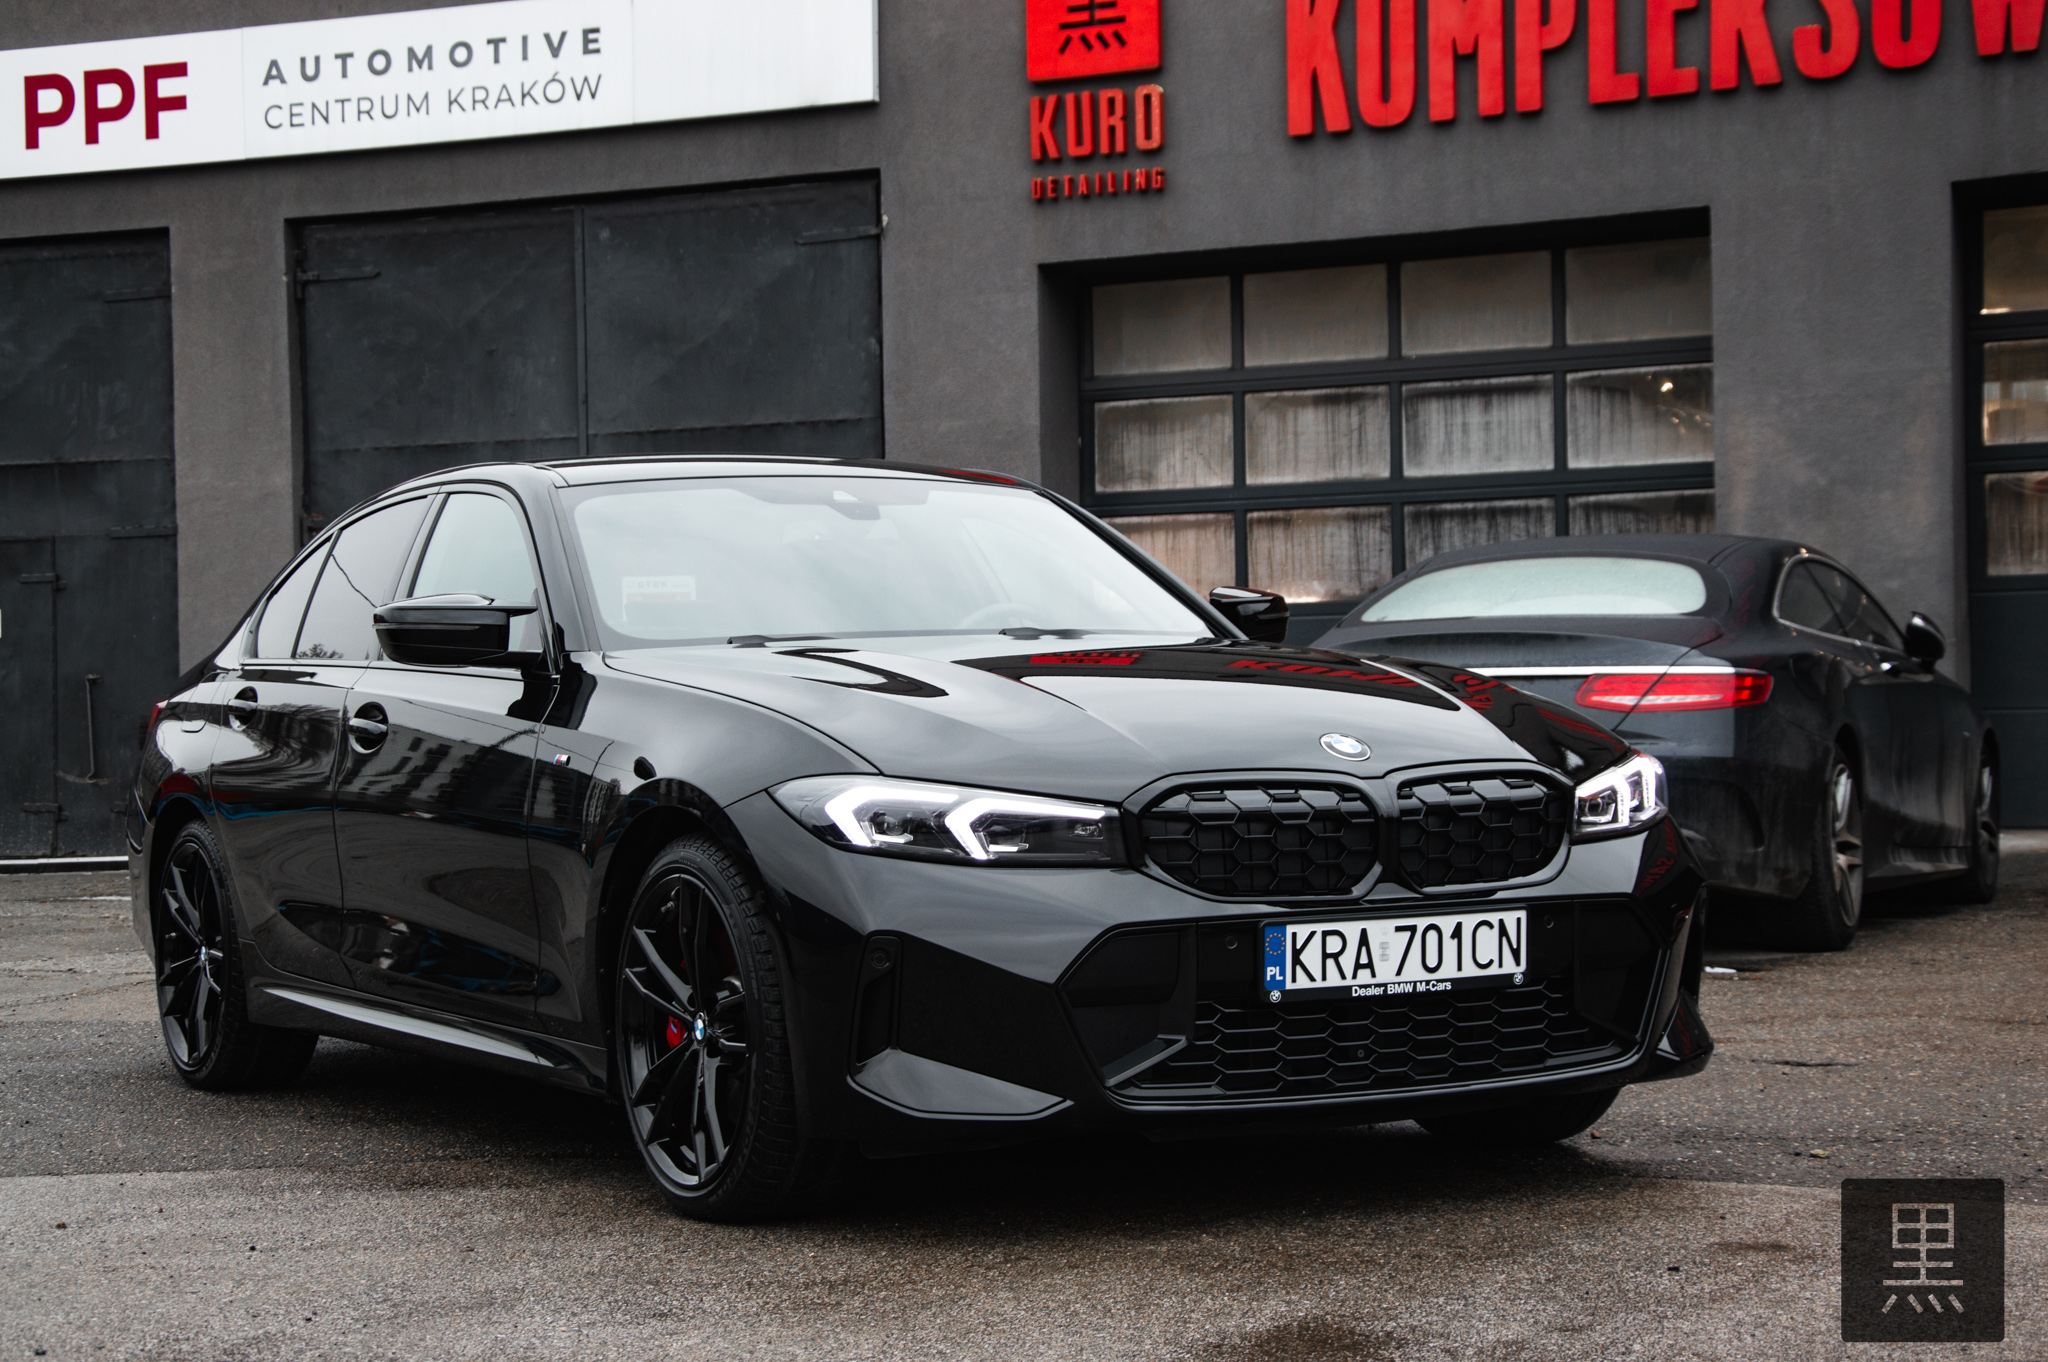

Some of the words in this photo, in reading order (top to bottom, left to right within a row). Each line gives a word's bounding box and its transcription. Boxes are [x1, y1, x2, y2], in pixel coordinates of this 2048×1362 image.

[262, 27, 602, 86] AUTOMOTIVE
[1285, 0, 2047, 137] KOMPLEK
[25, 62, 188, 150] PPF
[264, 92, 430, 130] CENTRUM
[448, 72, 603, 114] KRAKÓW
[1029, 83, 1165, 162] KURO
[1031, 166, 1166, 201] DETAILING
[1266, 966, 1284, 981] PL
[1291, 927, 1377, 984] KRA
[1394, 916, 1522, 977] 701CN
[1352, 985, 1385, 997] Dealer
[1387, 982, 1414, 995] BMW
[1416, 980, 1452, 992] M-Cars
